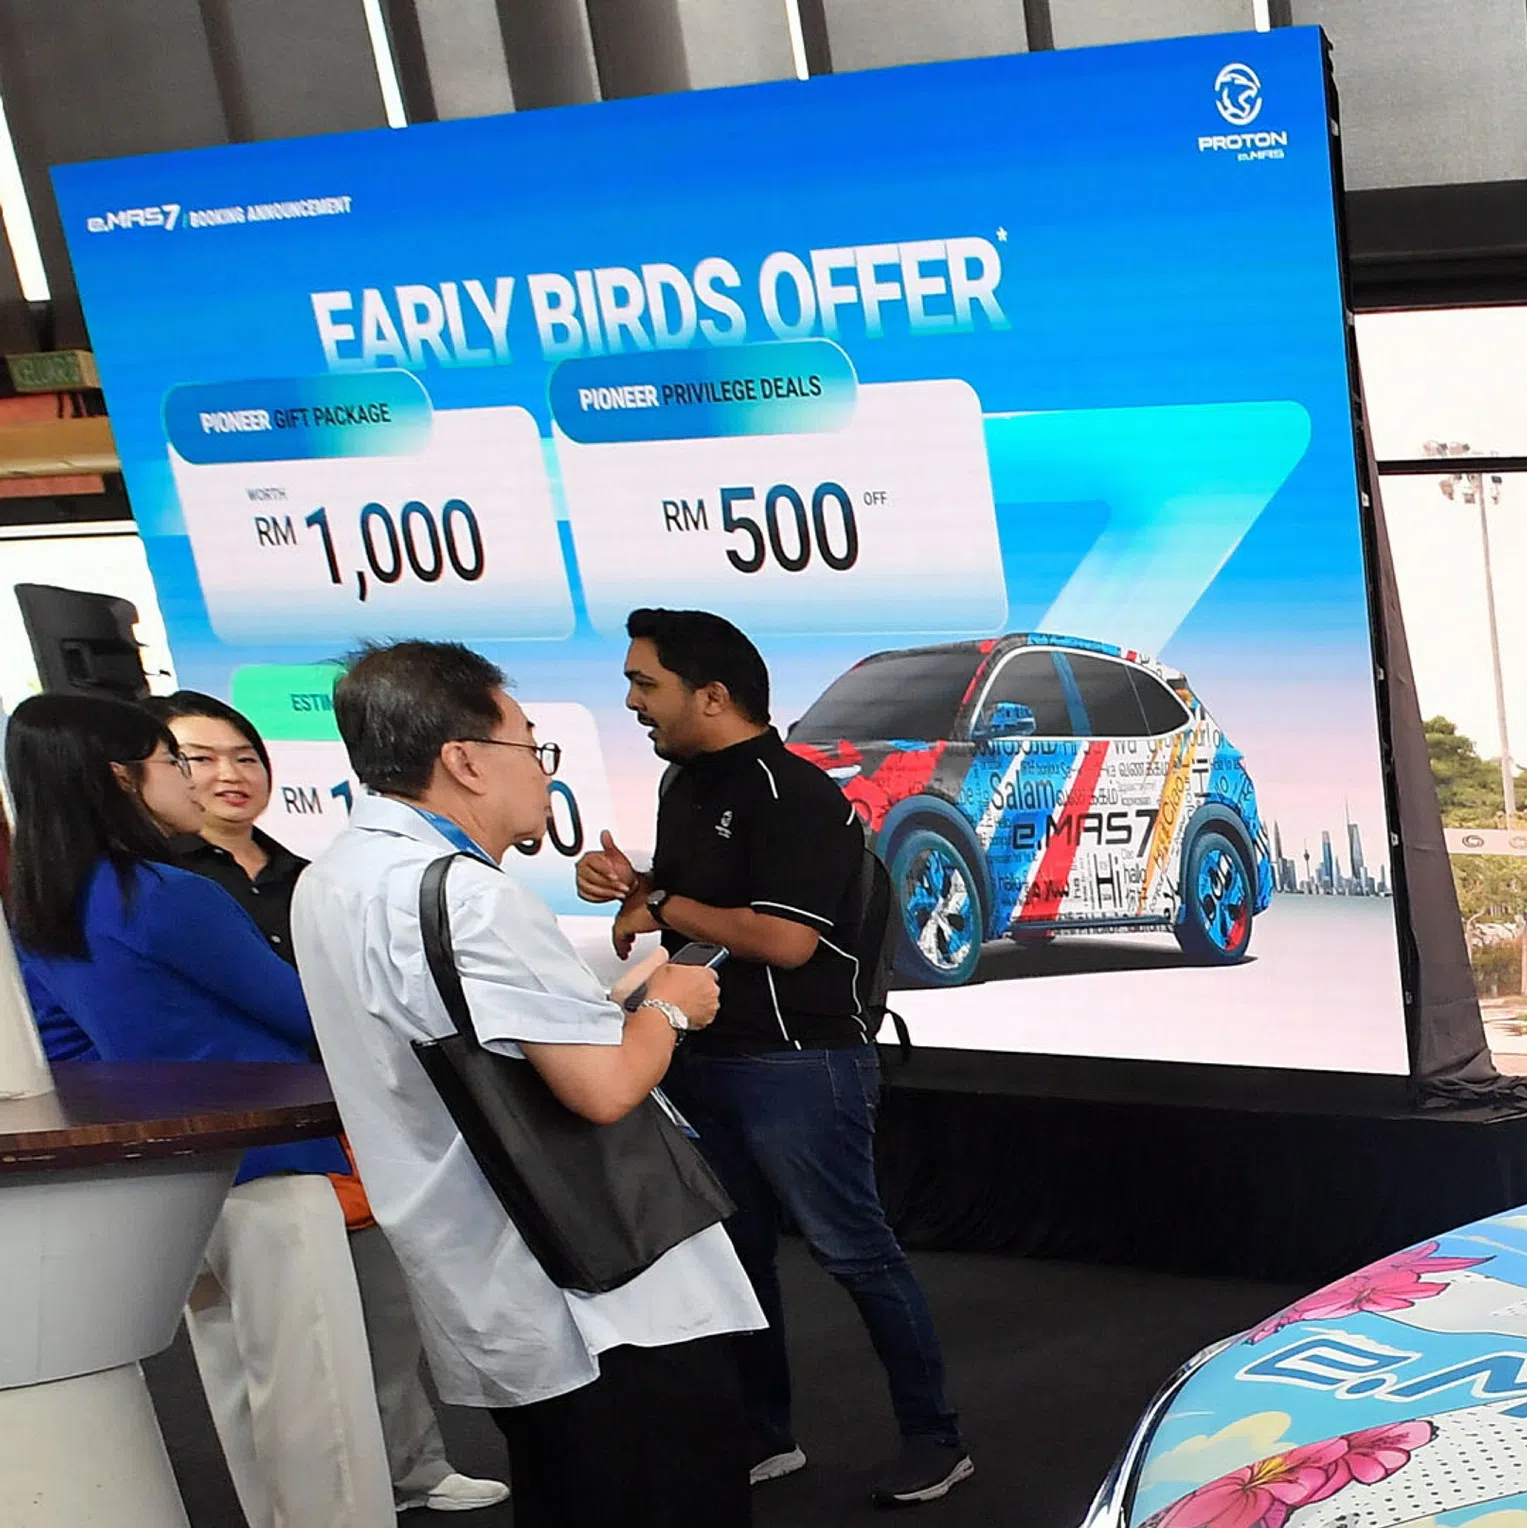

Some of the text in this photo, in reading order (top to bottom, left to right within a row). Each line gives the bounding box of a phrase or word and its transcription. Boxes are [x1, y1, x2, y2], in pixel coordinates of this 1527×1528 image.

[1197, 131, 1288, 152] PROTON
[189, 206, 246, 228] BOOKING
[247, 196, 352, 222] ANNOUNCEMENT
[310, 277, 515, 371] EARLY
[527, 257, 747, 363] BIRDS
[578, 375, 822, 411] PIONEER PRIVILEGE DEALS
[200, 403, 391, 434] PIONEER GIFT PACKAGE
[245, 487, 288, 502] WORTH
[661, 482, 888, 573] RM 500 OFF
[254, 498, 485, 602] RM 1,000
[281, 786, 323, 815] RM
[989, 770, 1056, 810] Salam
[1093, 853, 1123, 909] Hi
